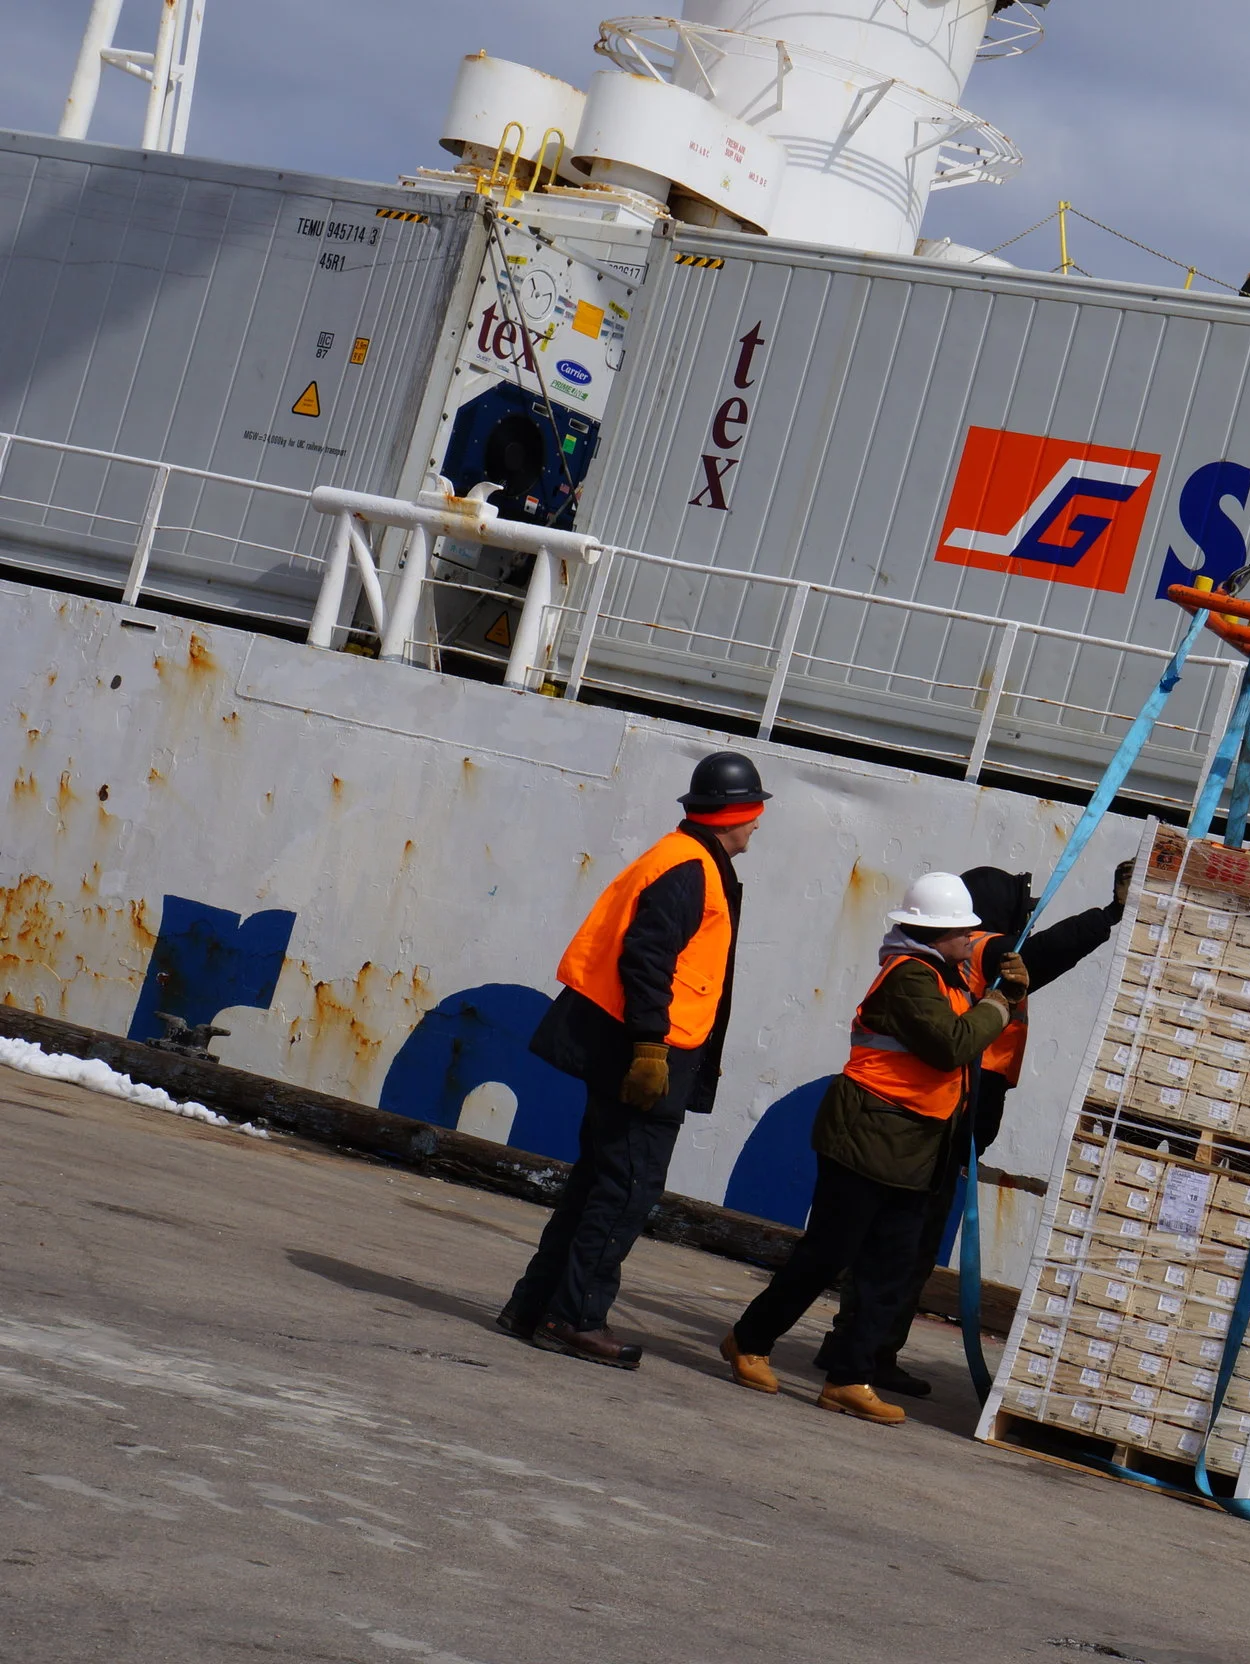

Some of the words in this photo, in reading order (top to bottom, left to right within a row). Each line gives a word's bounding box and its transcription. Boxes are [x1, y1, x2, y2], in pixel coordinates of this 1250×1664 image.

[297, 218, 325, 237] TEMU
[327, 221, 366, 242] 945714
[370, 229, 378, 245] 3
[319, 252, 346, 271] 45R1
[478, 300, 556, 374] tex
[316, 349, 328, 359] 87
[560, 363, 589, 381] Carrier
[688, 320, 764, 511] tex
